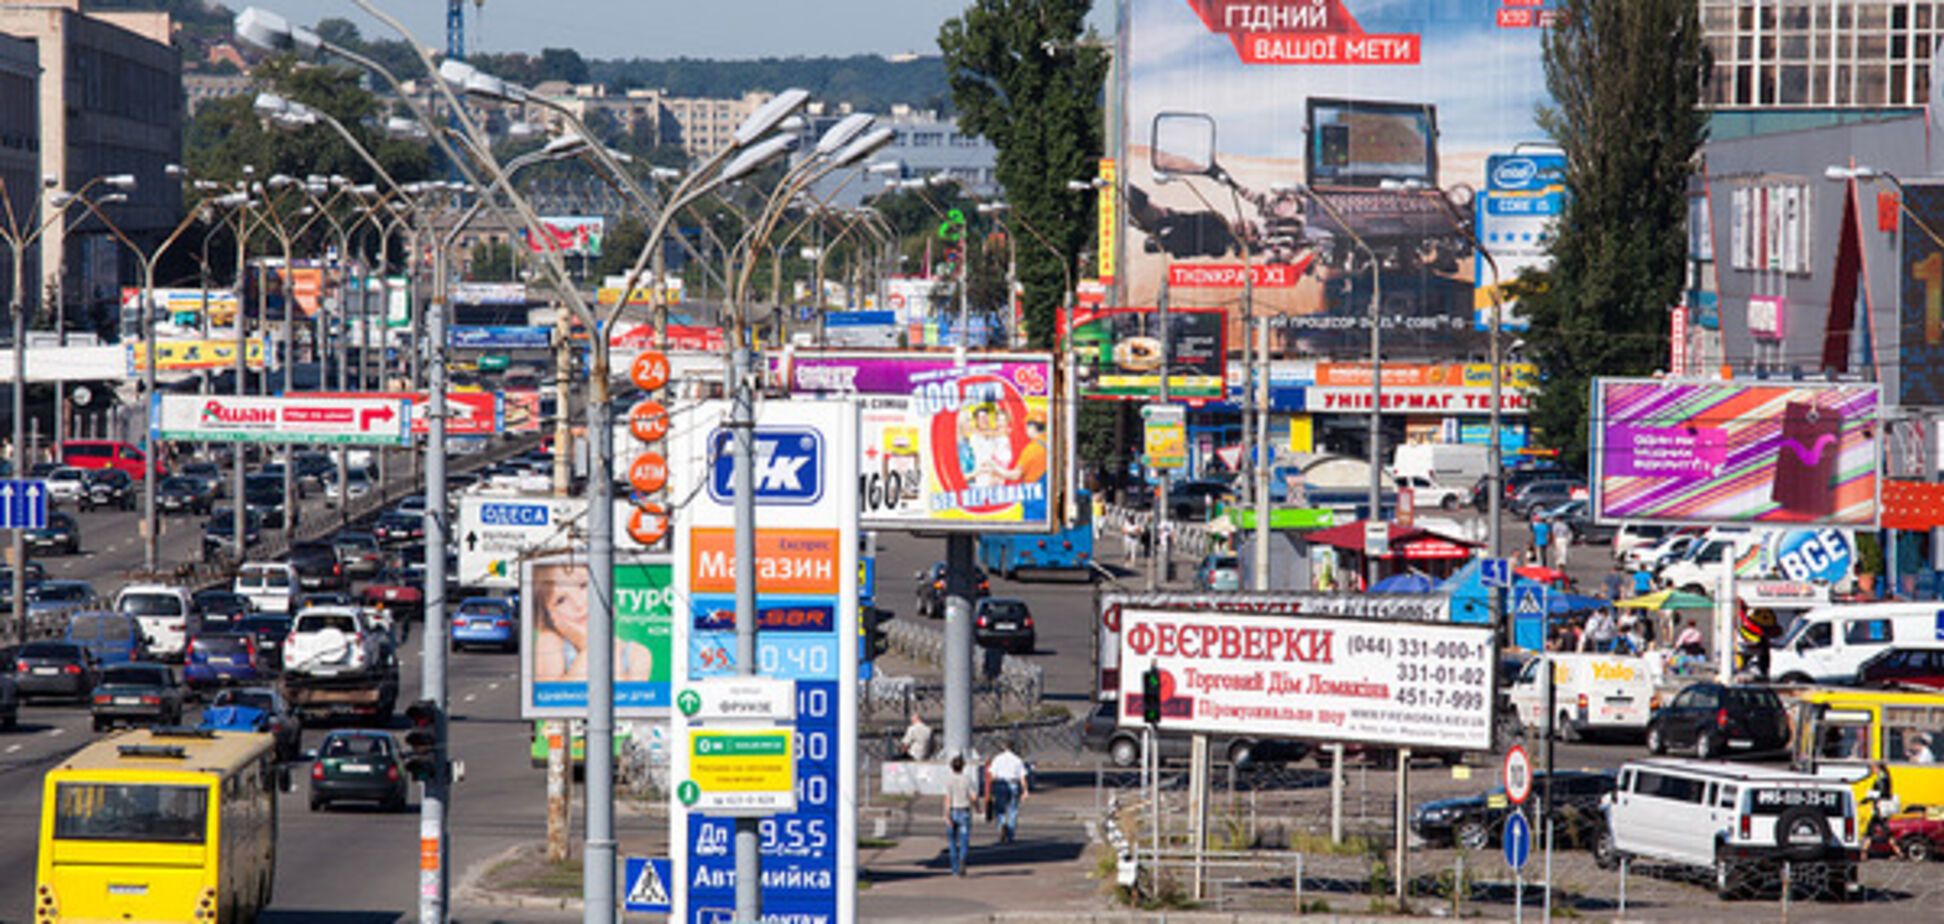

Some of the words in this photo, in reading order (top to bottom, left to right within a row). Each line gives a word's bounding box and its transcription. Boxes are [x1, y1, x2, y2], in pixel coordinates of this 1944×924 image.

[1225, 0, 1327, 31] ГІДНИЙ
[1254, 36, 1337, 59] ВАШОЇ
[1345, 39, 1411, 59] МЕТИ
[638, 359, 665, 381] 24
[634, 412, 665, 432] WC
[634, 466, 665, 482] ATM
[484, 507, 546, 523] ОДЕСА
[699, 551, 832, 578] Мазин
[1781, 527, 1848, 580] ВСЕ
[715, 608, 826, 629] PSAR
[1127, 622, 1334, 664] ФЕЄРВЕРКИ
[1348, 634, 1392, 658] (044)
[1398, 637, 1485, 661] 331-000-1
[1184, 667, 1264, 694] Торговий
[1266, 670, 1303, 696] Дім
[1396, 661, 1486, 687] 331-01-02
[1396, 687, 1484, 711] 451-7-999
[694, 864, 831, 889] Автийка
